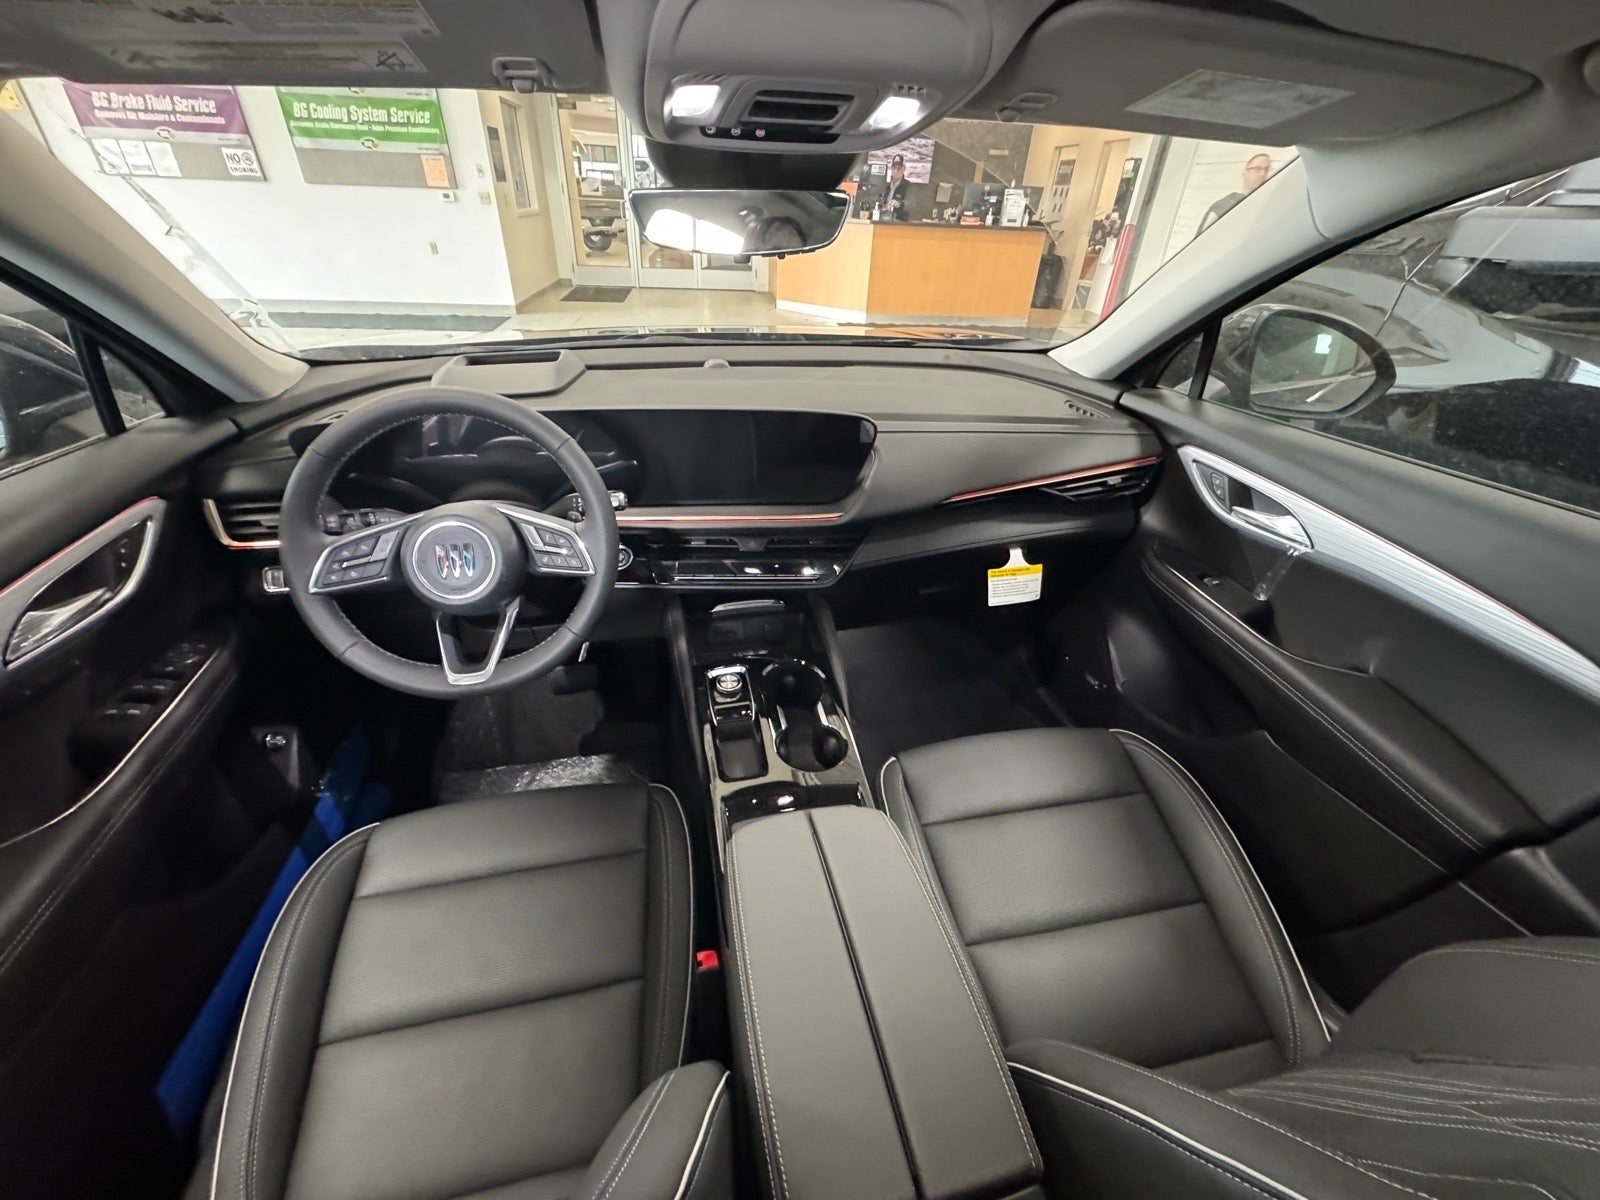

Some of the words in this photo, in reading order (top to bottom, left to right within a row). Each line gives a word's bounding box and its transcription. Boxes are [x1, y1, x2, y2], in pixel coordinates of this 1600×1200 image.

[91, 91, 109, 107] BG
[110, 92, 145, 110] Brake
[145, 94, 173, 111] Fluid
[173, 95, 217, 113] Service
[293, 102, 308, 118] BG
[309, 102, 348, 123] Cooling
[349, 105, 388, 124] System
[390, 107, 431, 124] Service
[225, 152, 241, 164] NO
[230, 166, 259, 174] SMOKING
